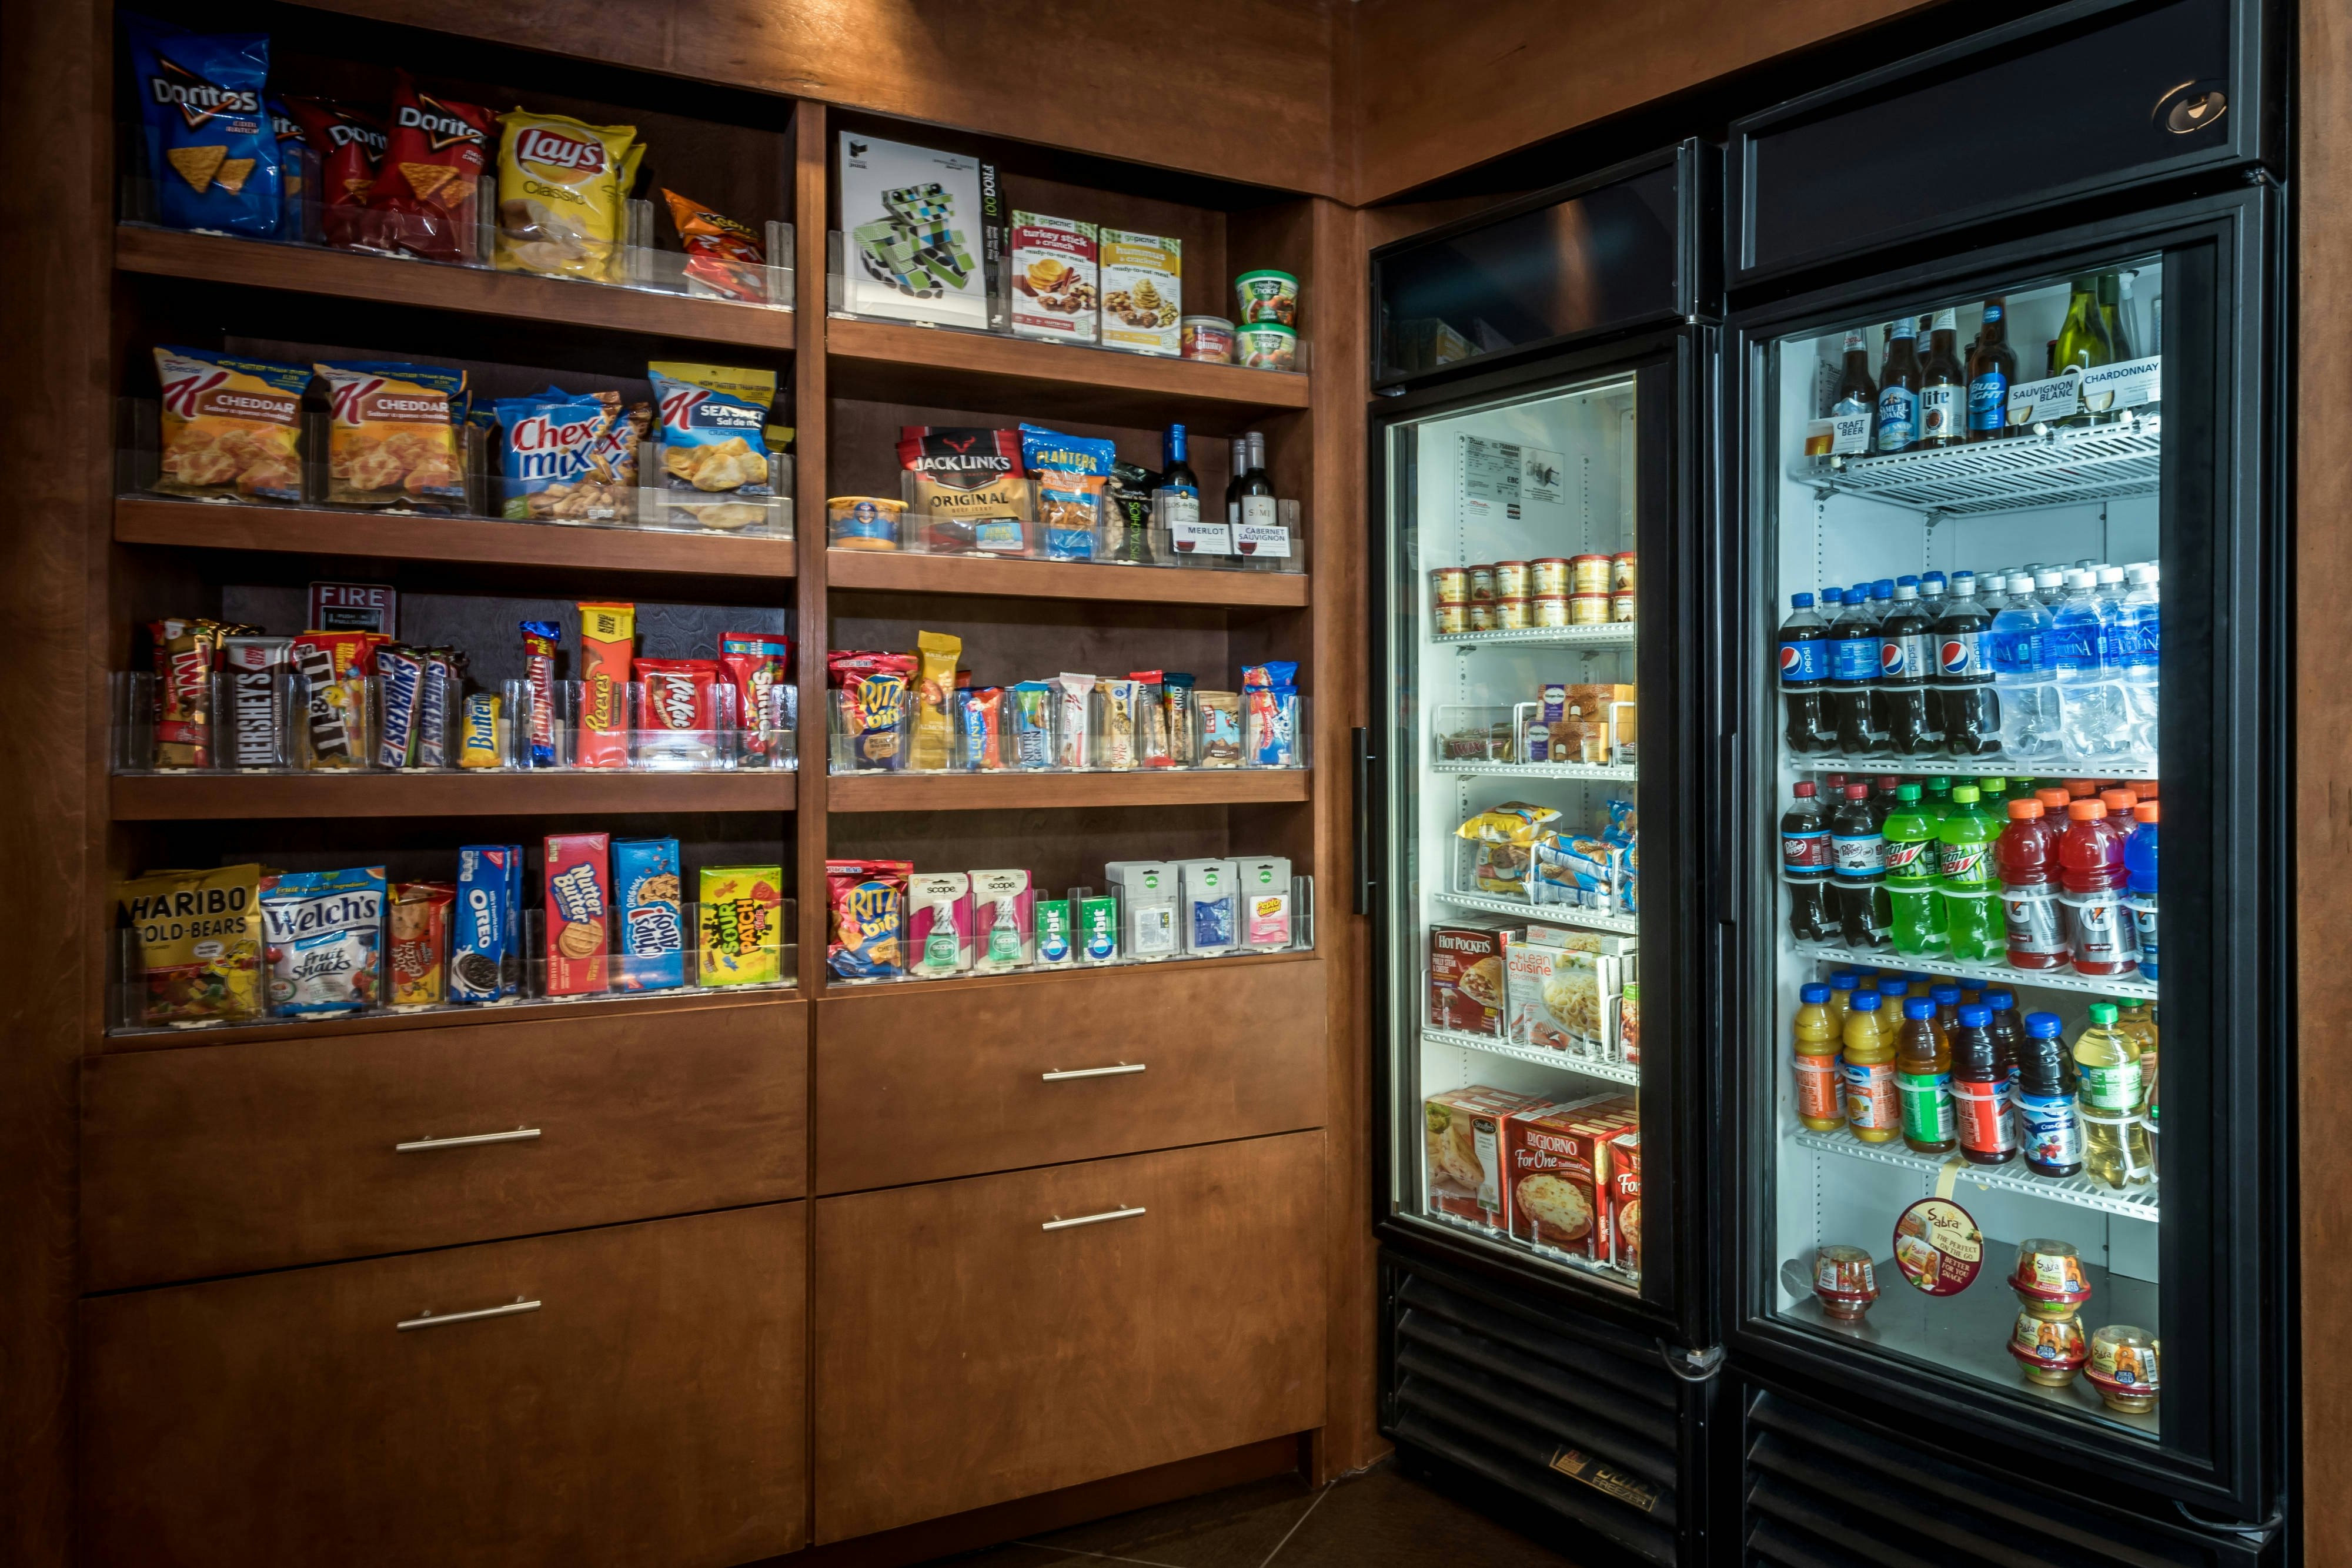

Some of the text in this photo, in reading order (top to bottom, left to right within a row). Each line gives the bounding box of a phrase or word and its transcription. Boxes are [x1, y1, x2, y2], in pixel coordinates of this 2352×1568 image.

[152, 78, 259, 112] Doritos
[521, 130, 604, 173] Lay's
[523, 180, 585, 206] Classic
[1023, 229, 1088, 247] turkey stick
[1043, 240, 1075, 250] crunch
[1124, 235, 1157, 245] gopicnic
[1025, 249, 1067, 259] ready-to-eat
[163, 363, 203, 375] Special
[2084, 362, 2160, 385] CHARDONNAY
[162, 371, 230, 418] K
[1972, 382, 2000, 392] BUD
[2012, 380, 2074, 400] SAUVIGNON
[2039, 388, 2073, 402] BLANC
[216, 394, 296, 414] CHEDDAR
[332, 379, 387, 424] K
[376, 399, 449, 412] CHEDDAR
[661, 390, 711, 430] K
[700, 405, 730, 416] SEA
[1879, 404, 1909, 413] SAMUEL
[1921, 390, 1950, 410] Lite
[716, 417, 745, 427] Sal de
[1836, 419, 1866, 431] CRAFT
[1879, 411, 1907, 420] ADAMS
[513, 418, 599, 452] Chex
[1842, 427, 1864, 437] BEER
[522, 441, 596, 479] mix
[915, 456, 960, 471] JACK
[1036, 451, 1098, 472] PLANTERS
[930, 493, 1009, 507] ORIGINAL
[1129, 502, 1141, 560] PISTACHIOS
[1188, 527, 1224, 535] MERLOT
[320, 586, 385, 607] FIRE
[597, 614, 607, 634] KING
[606, 614, 616, 635] SIZE
[1804, 647, 1813, 673] pepsi
[1909, 644, 1917, 672] pepsi
[383, 656, 420, 748] SNICKERS
[584, 672, 610, 735] Reese's
[752, 671, 774, 741] Skittles
[858, 680, 906, 714] RITZ
[1174, 686, 1184, 711] KIND
[235, 673, 274, 764] HERSHEY'S
[866, 706, 901, 731] bits
[971, 713, 983, 760] LUNA
[1023, 731, 1034, 762] NUTRI
[1034, 730, 1043, 762] GRAIN
[1449, 741, 1482, 756] TWIX
[570, 863, 603, 917] Nutter
[626, 875, 647, 908] ORIGINAL
[927, 885, 957, 895] scope
[988, 881, 1016, 891] scope
[132, 886, 246, 921] HARIBO
[553, 874, 589, 924] Butter
[847, 887, 900, 921] RITZ
[266, 895, 377, 936] Welch's
[469, 888, 492, 948] OREO
[1258, 904, 1281, 916] Bismol
[719, 902, 739, 954] SOUR
[737, 898, 756, 955] PATCH
[861, 913, 900, 940] bits
[1439, 935, 1491, 953] HOT POCKETS
[303, 947, 344, 967] Fruit
[1523, 952, 1551, 966] Lean
[292, 959, 352, 981] Snacks
[1515, 1148, 1591, 1175] For One Traditional Crust
[1927, 1208, 1959, 1229] Sabra
[1937, 1233, 1977, 1253] THE PERFECT
[1950, 1248, 1962, 1257] THE
[1942, 1263, 1969, 1278] FOR YOU
[1945, 1256, 1970, 1272] BETTER
[2036, 1259, 2060, 1272] Sabra
[1942, 1270, 1963, 1284] SNACK
